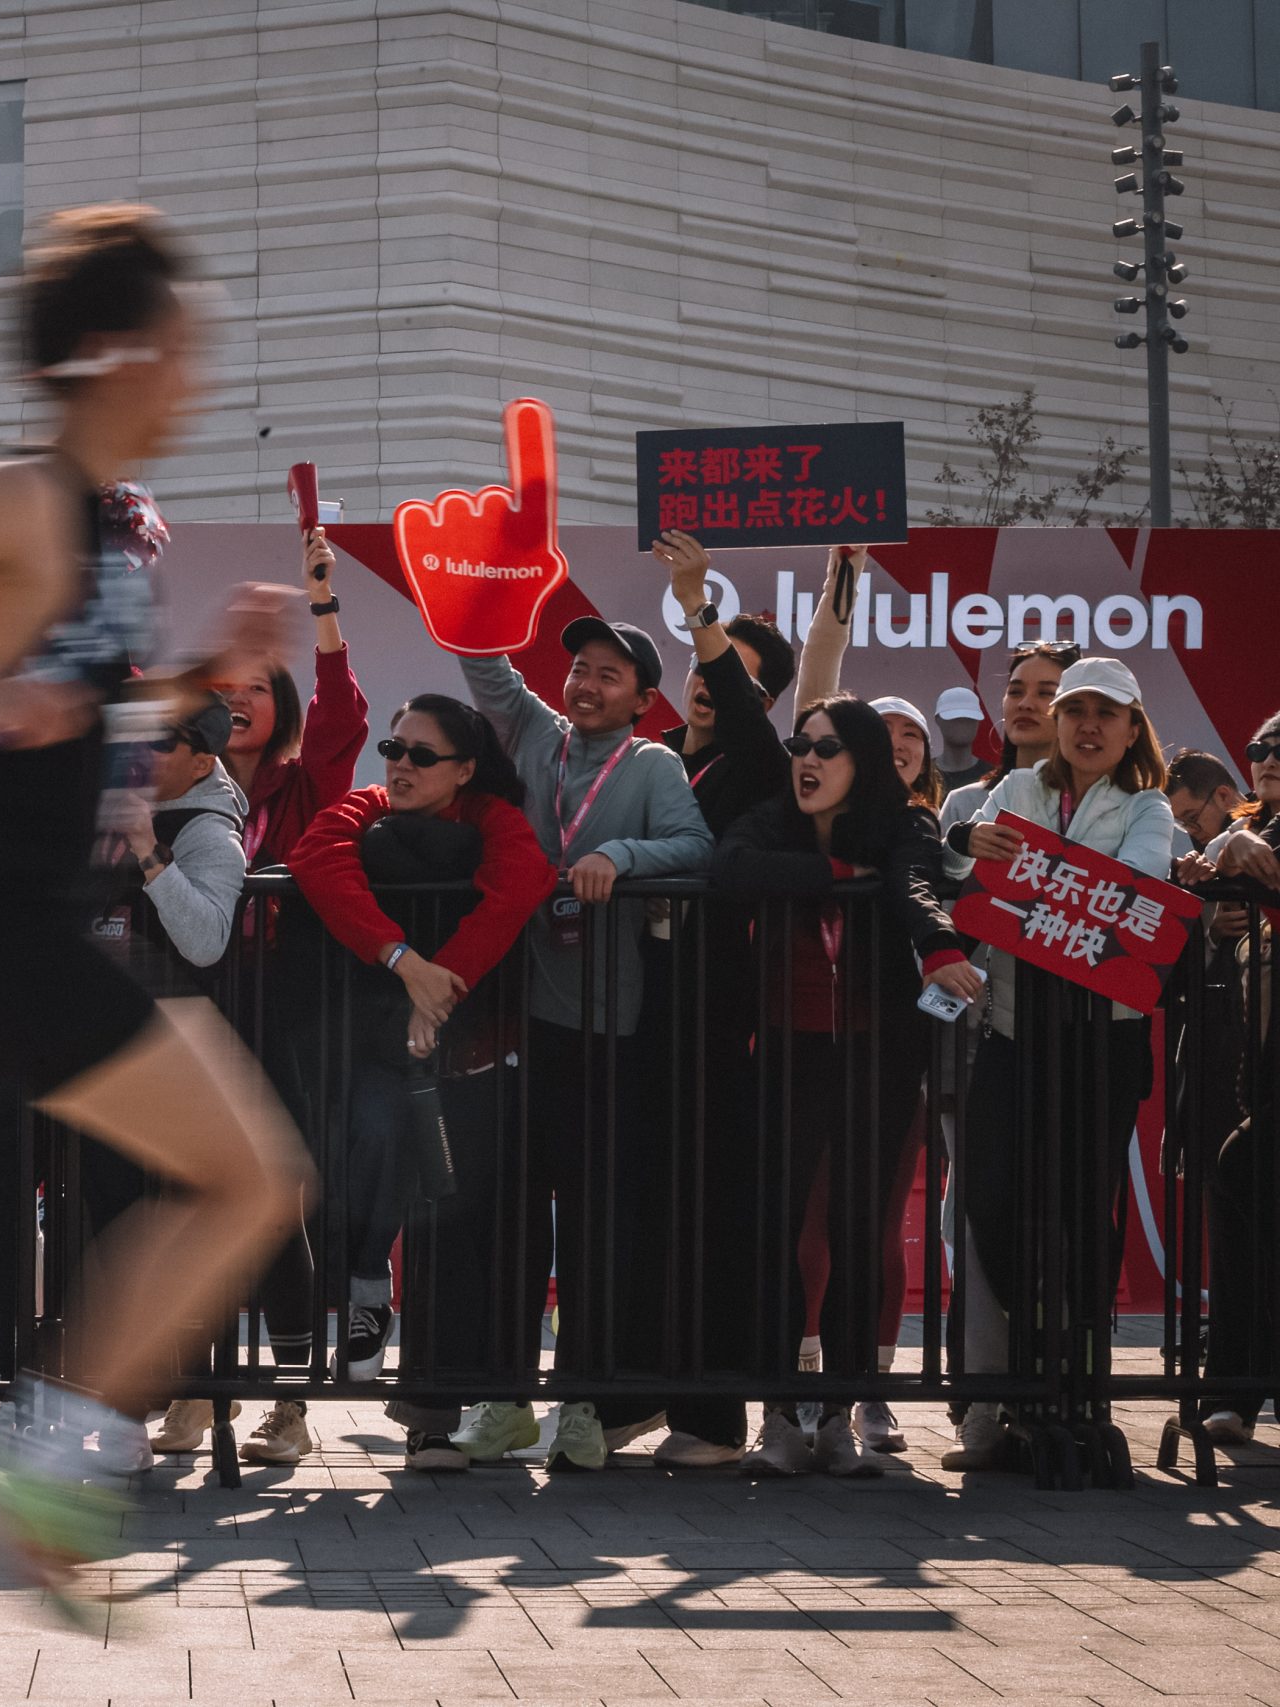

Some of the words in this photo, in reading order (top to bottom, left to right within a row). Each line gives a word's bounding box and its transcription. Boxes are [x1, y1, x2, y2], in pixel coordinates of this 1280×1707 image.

[657, 443, 823, 487] 来都来了
[658, 486, 887, 532] 跑出点花火！
[446, 557, 543, 579] lululemon
[1006, 842, 1165, 943] 快乐也是
[989, 896, 1107, 967] 一种快
